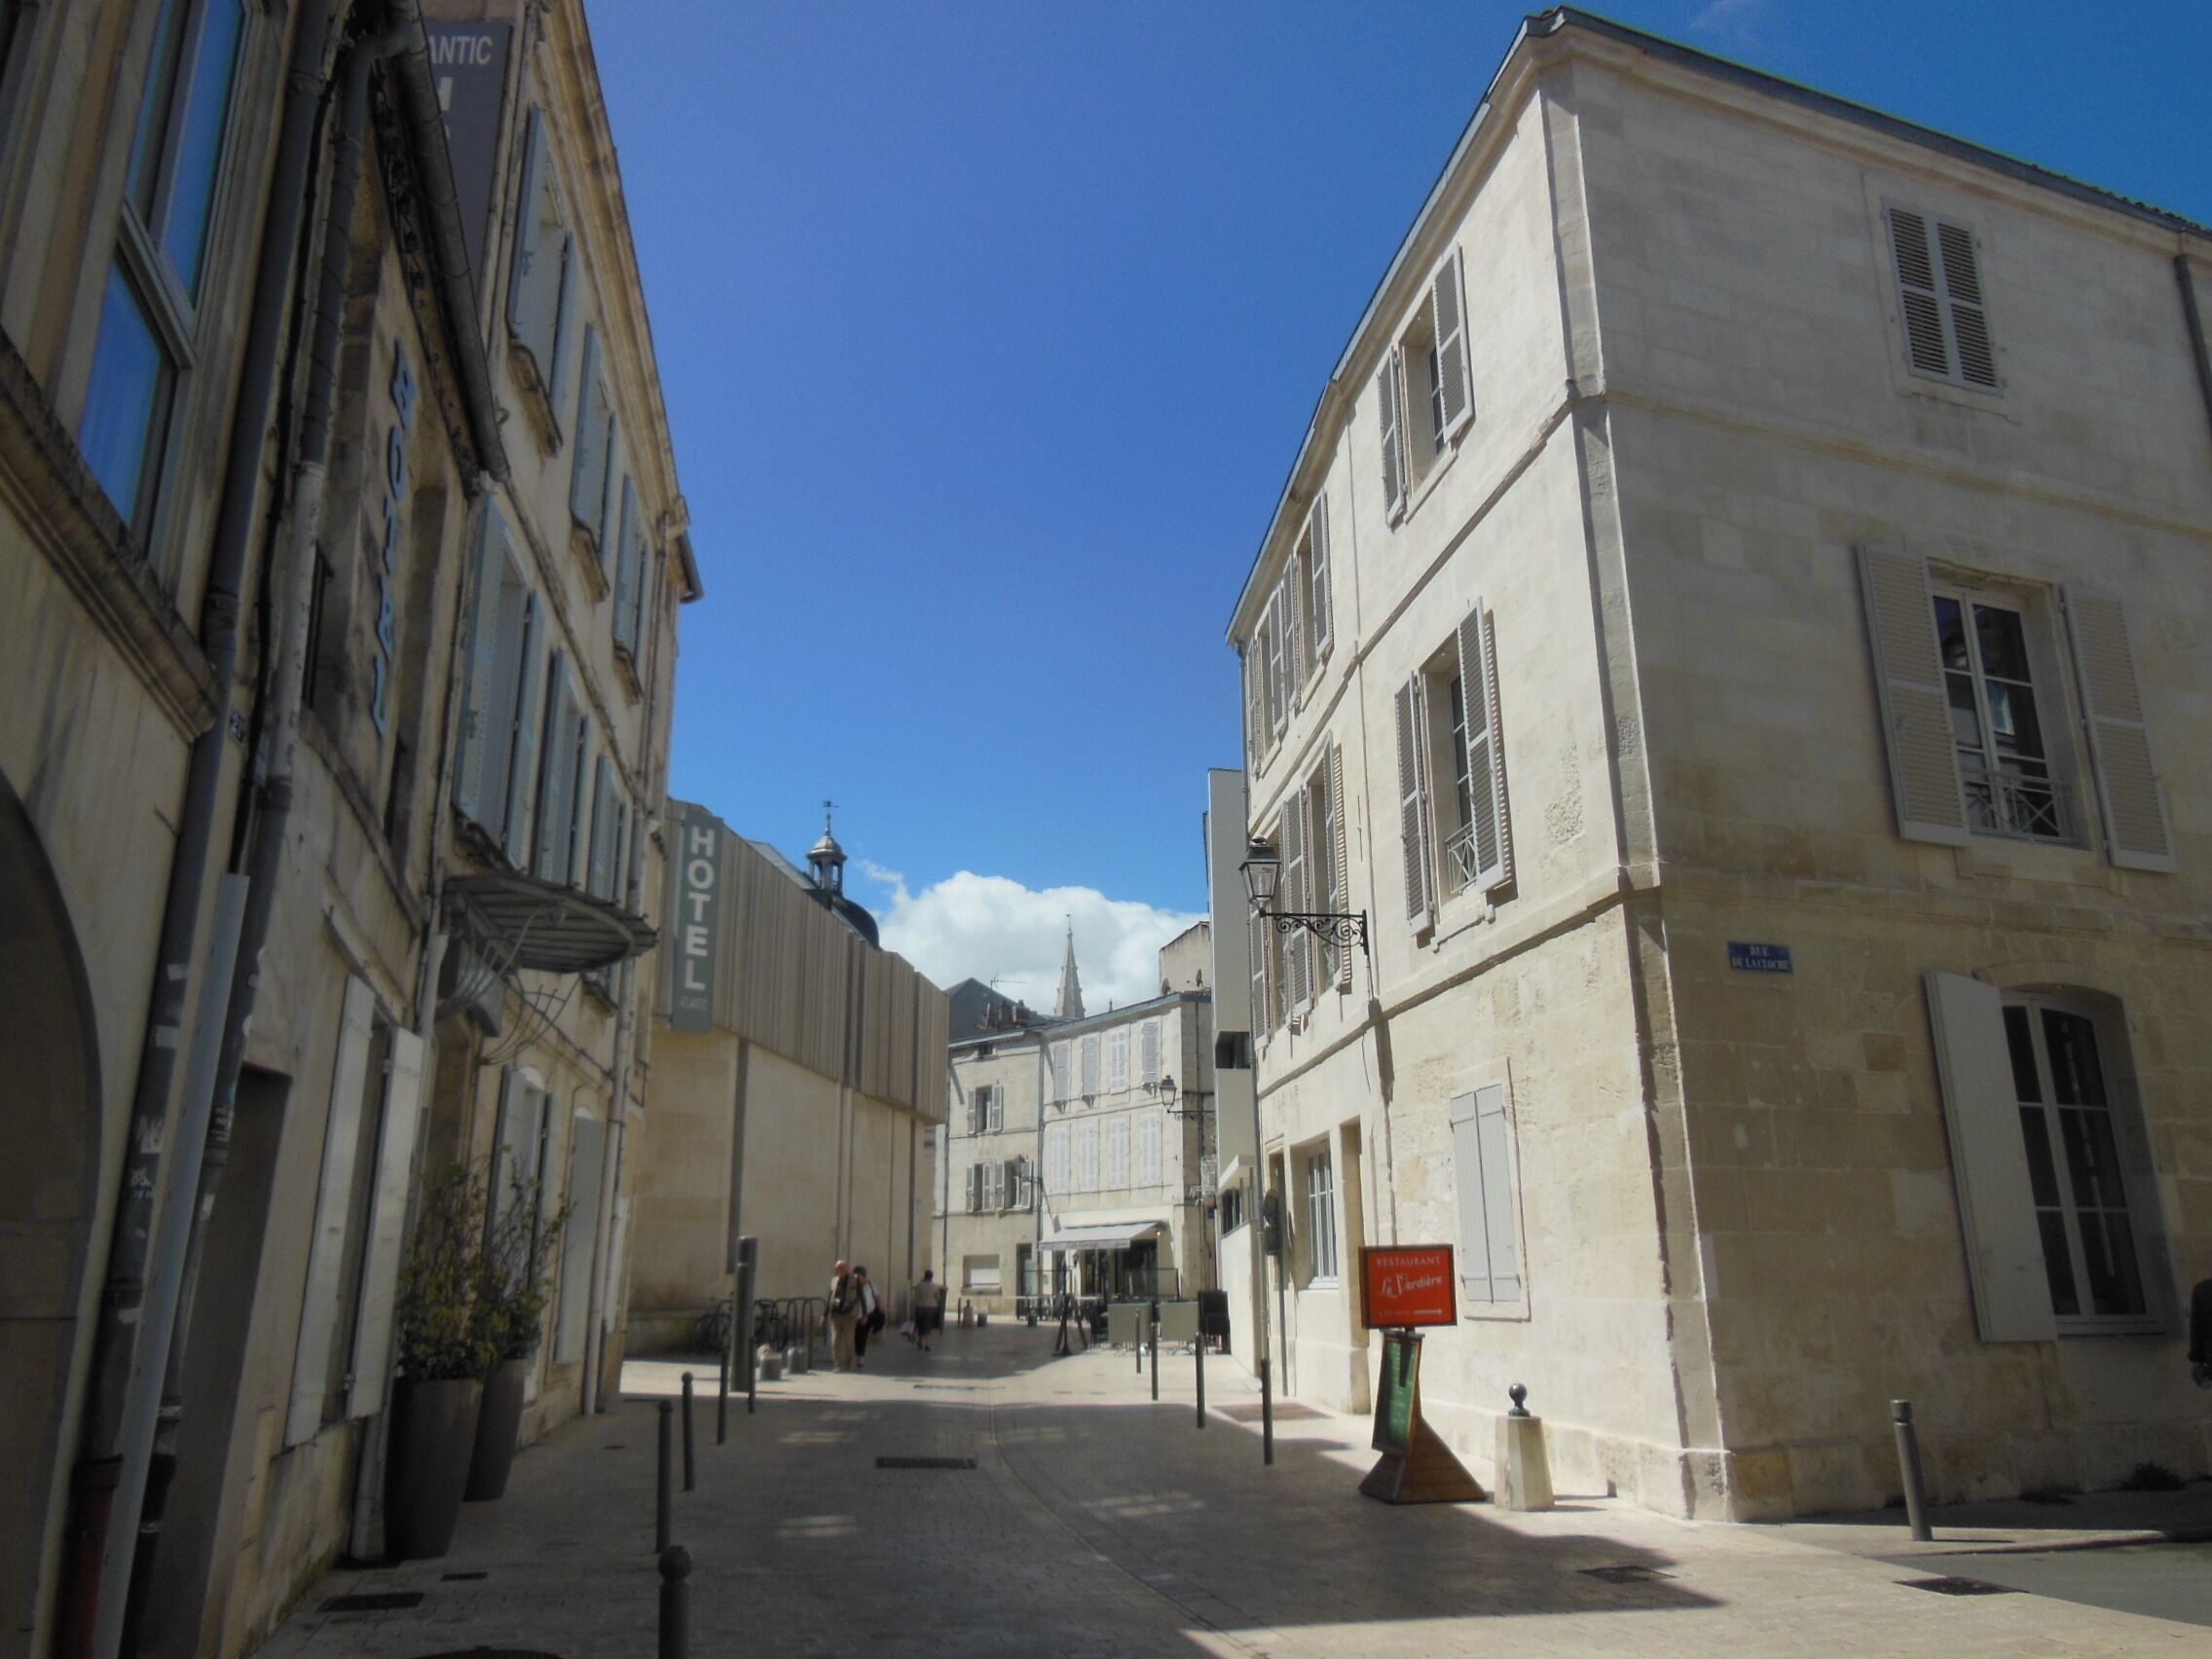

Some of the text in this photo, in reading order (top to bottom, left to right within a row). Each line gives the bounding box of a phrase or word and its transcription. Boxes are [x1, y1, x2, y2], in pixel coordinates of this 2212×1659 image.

[685, 826, 716, 991] HOTEL
[1750, 945, 1770, 957] RUE
[1732, 956, 1746, 968] DE
[1377, 1255, 1440, 1267] RESTAURANT
[1396, 1272, 1442, 1295] Verdière
